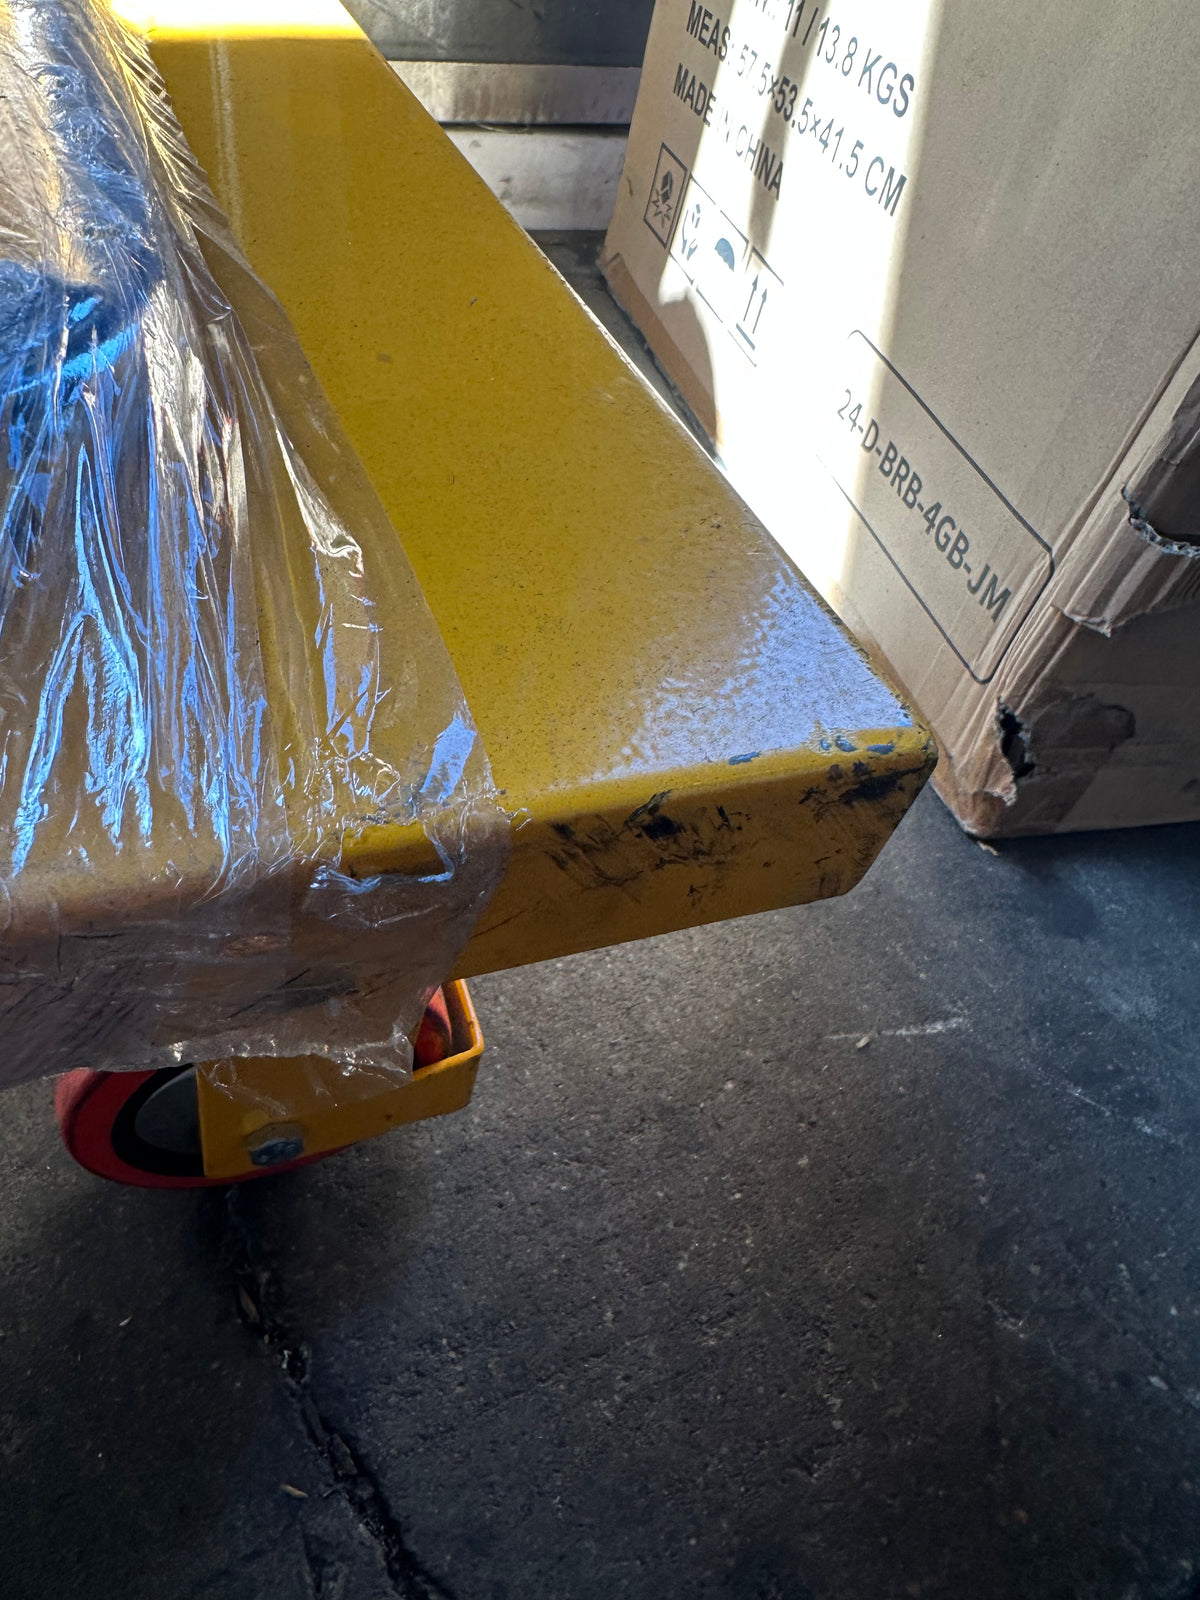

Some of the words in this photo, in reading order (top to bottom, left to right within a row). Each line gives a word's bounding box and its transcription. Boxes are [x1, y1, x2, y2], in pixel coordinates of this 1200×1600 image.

[672, 63, 716, 127] MADE
[735, 125, 784, 201] CHINA
[858, 48, 914, 118] KGS
[864, 156, 908, 216] CM
[836, 388, 1012, 623] 24-D-BRB-4GB-JM
